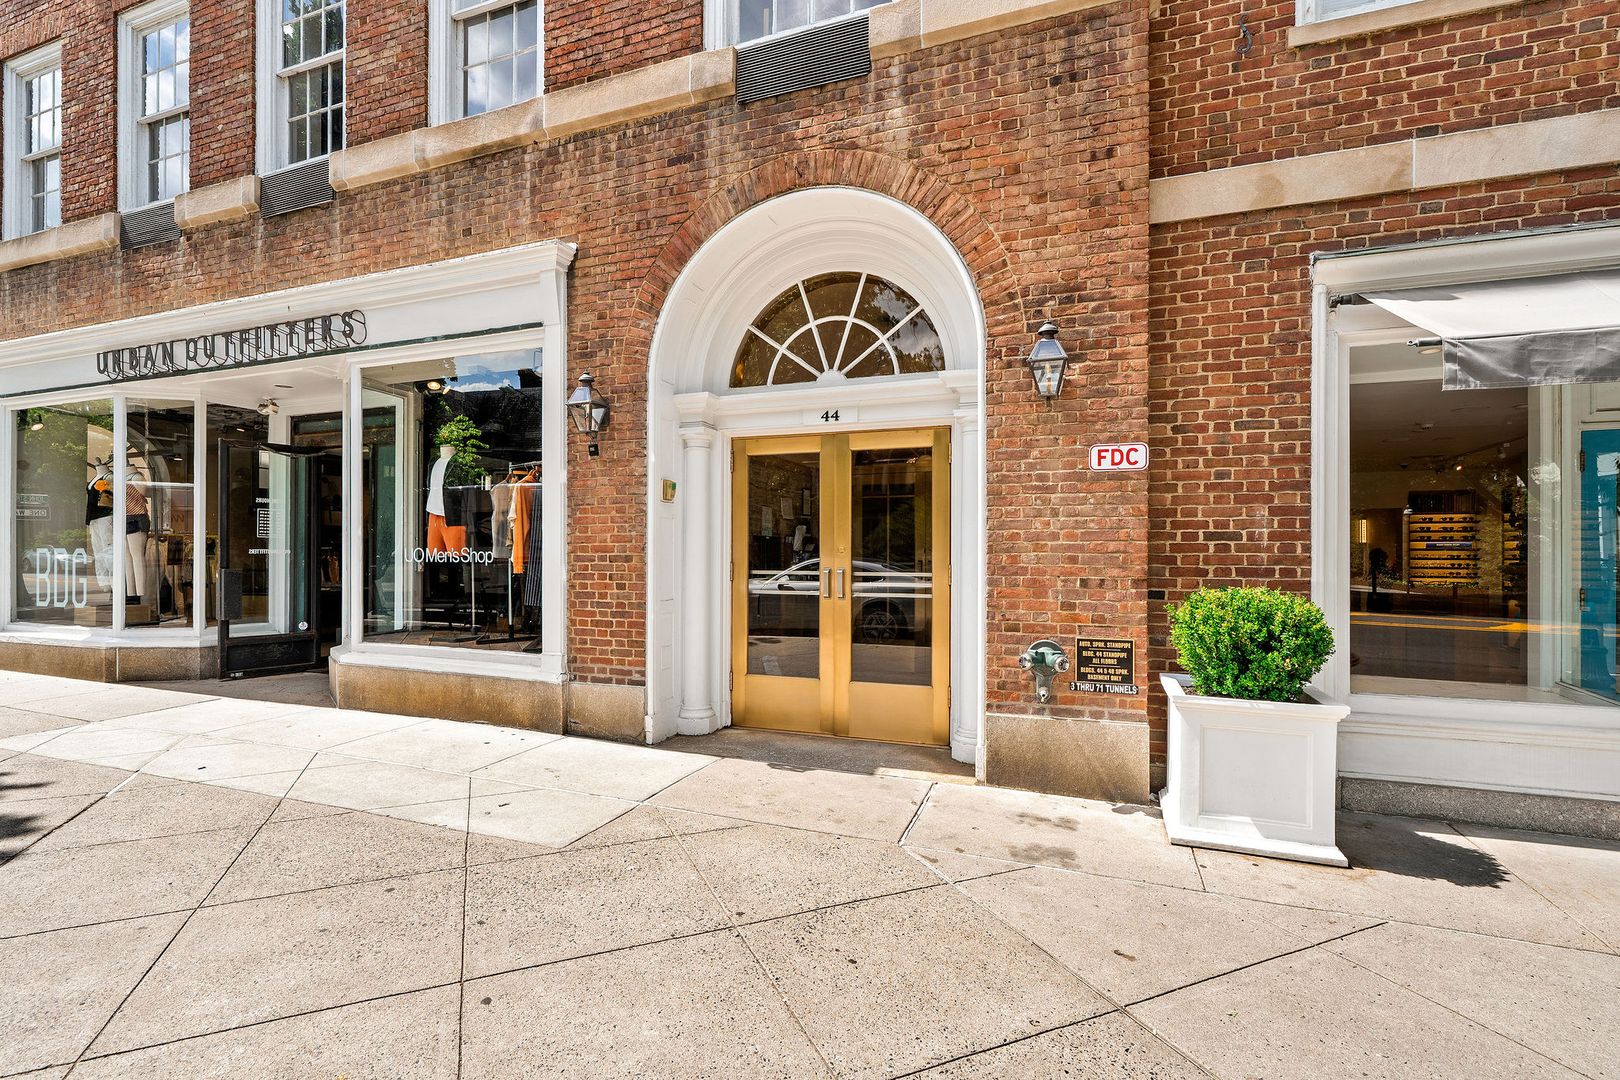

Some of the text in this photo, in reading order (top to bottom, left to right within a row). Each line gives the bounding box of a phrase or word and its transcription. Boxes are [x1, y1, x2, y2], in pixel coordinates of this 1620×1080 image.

[97, 309, 367, 380] URBAN OUTFITTERS
[821, 410, 840, 422] 44
[1097, 448, 1138, 466] FDC
[425, 547, 460, 563] Men's
[460, 547, 494, 566] Shop
[36, 548, 87, 608] BDG
[1071, 682, 1137, 695] 3 THRU 71 TUNNELS
